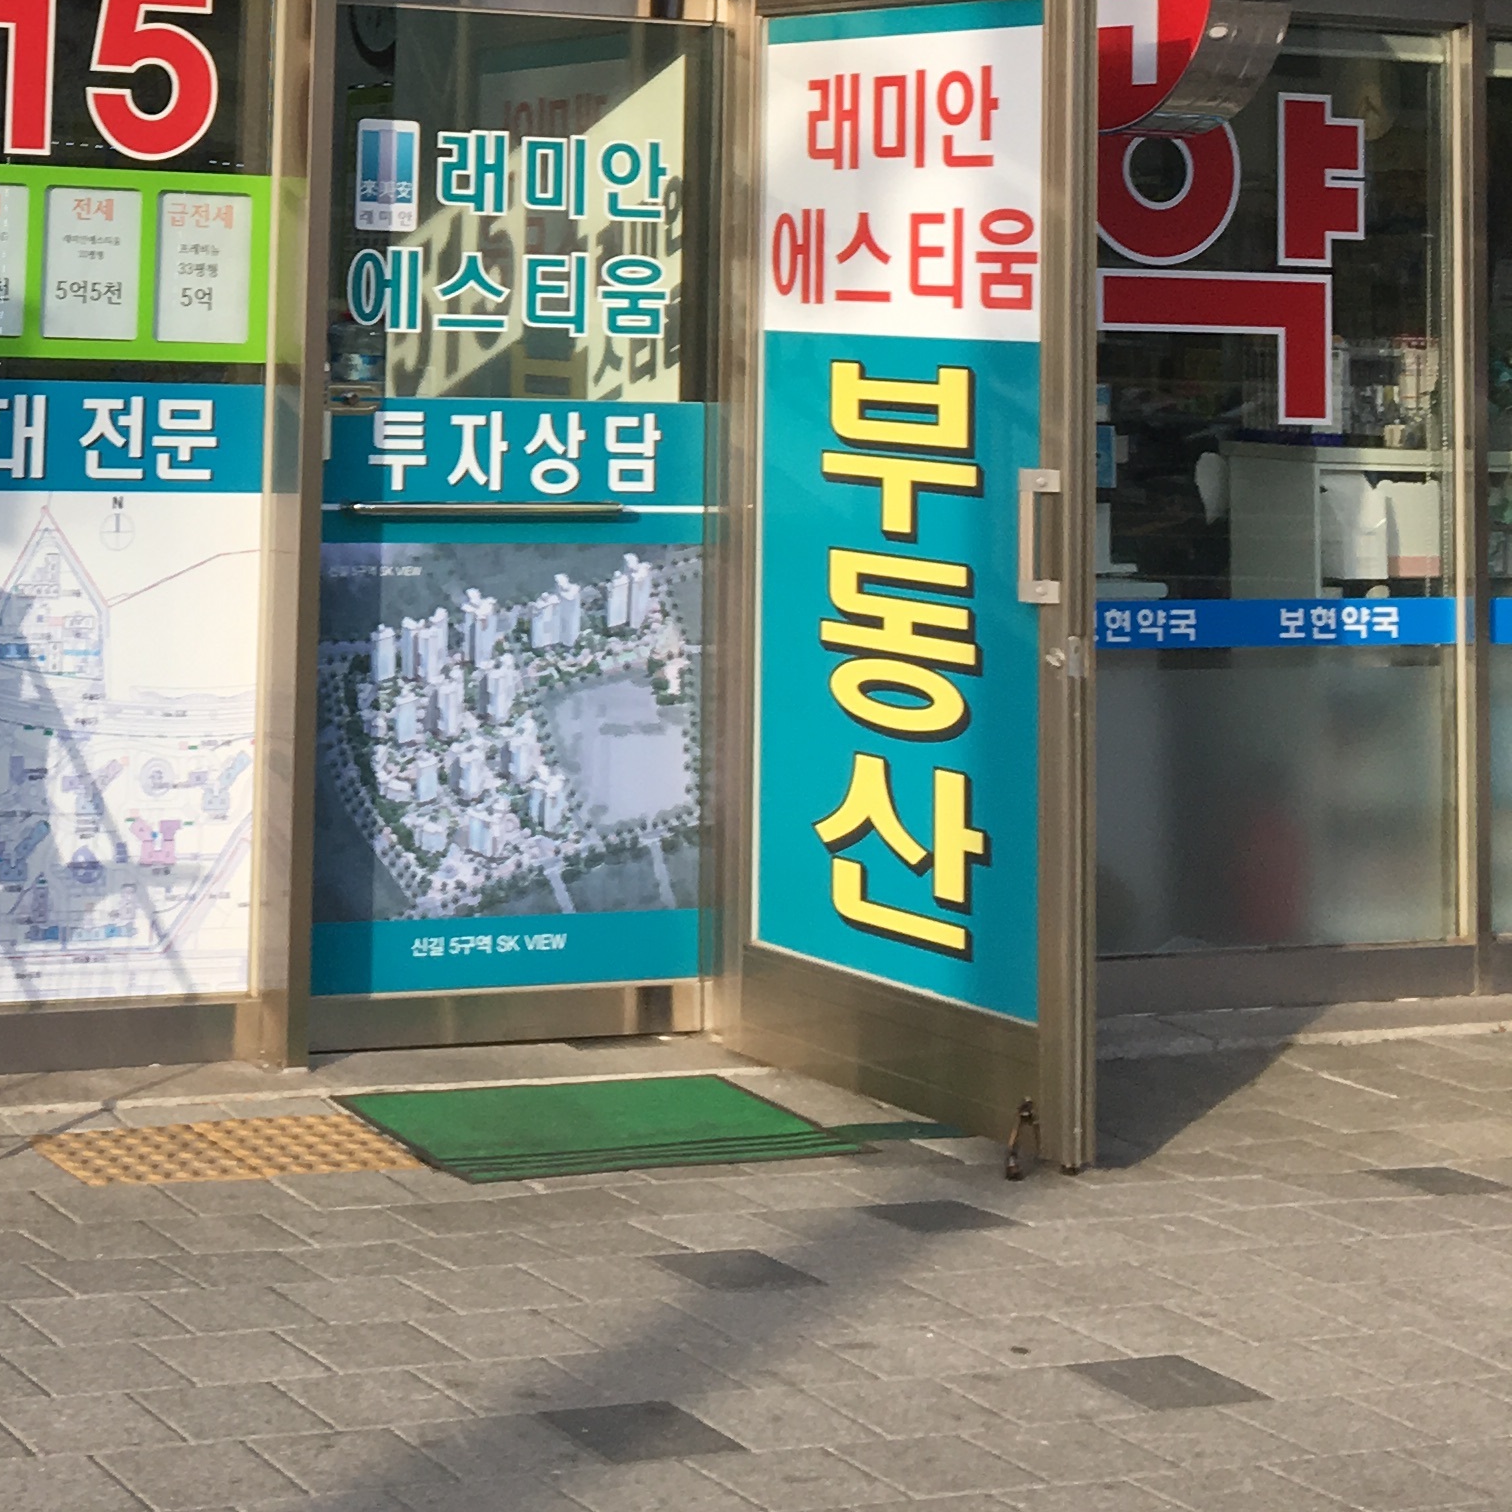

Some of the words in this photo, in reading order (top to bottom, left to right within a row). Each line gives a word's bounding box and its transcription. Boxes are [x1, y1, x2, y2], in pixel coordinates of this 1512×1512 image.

[806, 64, 1000, 171] 래미안
[436, 129, 669, 223] 래미안
[71, 196, 115, 222] 전세
[167, 201, 235, 230] 급전세
[177, 261, 219, 278] 33평형
[771, 206, 1039, 312] 에스티움
[1097, 92, 1366, 428] 약
[54, 279, 123, 306] 5억5천
[179, 286, 214, 312] 5억
[346, 246, 671, 339] 에스티움
[78, 394, 219, 482] 전문
[367, 409, 664, 495] 투자상담
[112, 497, 124, 510] N
[1095, 608, 1197, 642] 현약국
[1279, 606, 1400, 640] 보현약국
[812, 358, 992, 963] 부동산
[410, 935, 445, 958] 신길
[496, 934, 521, 953] SK
[523, 933, 568, 951] VIEW
